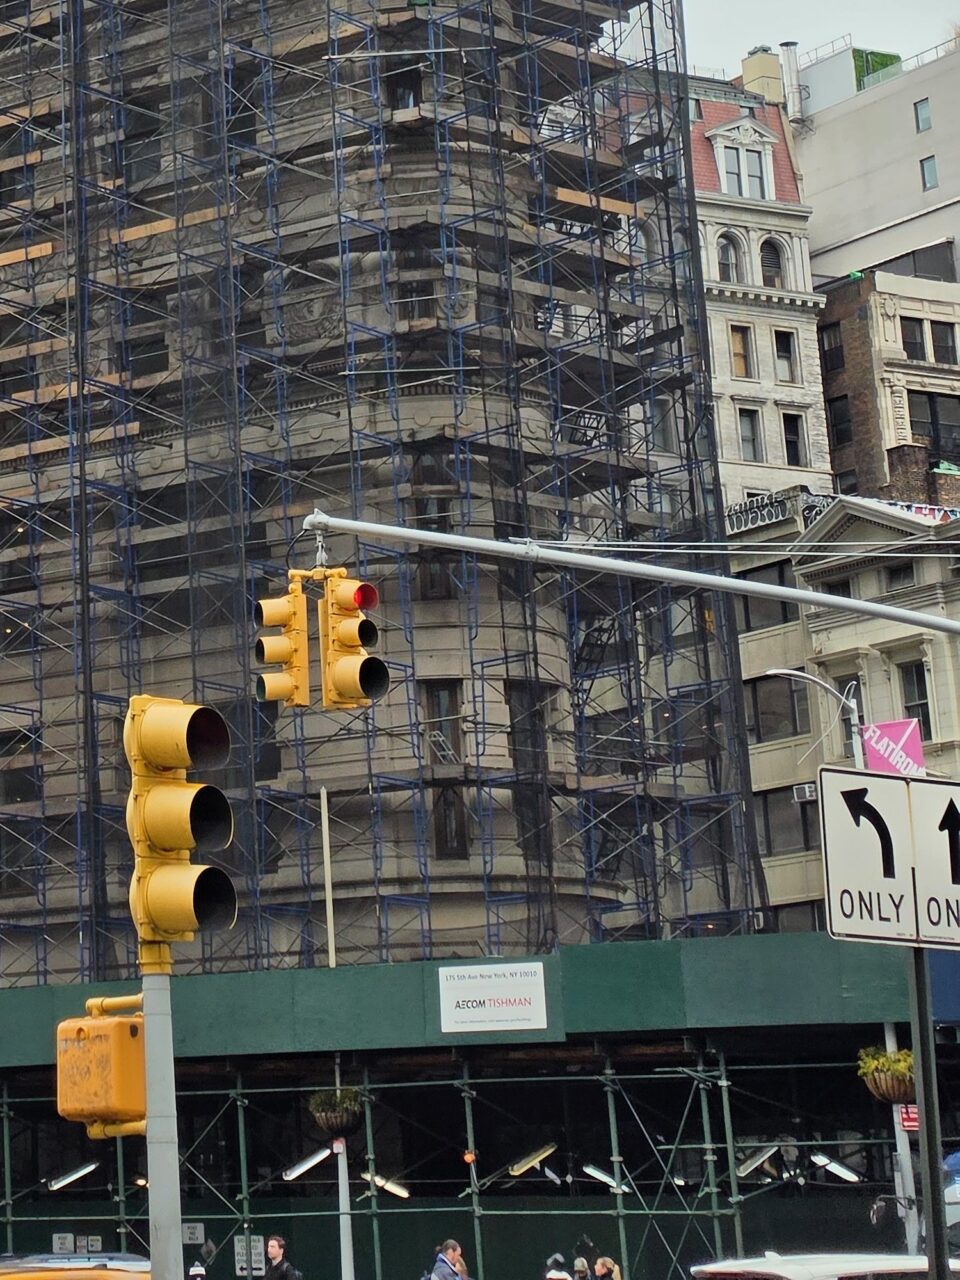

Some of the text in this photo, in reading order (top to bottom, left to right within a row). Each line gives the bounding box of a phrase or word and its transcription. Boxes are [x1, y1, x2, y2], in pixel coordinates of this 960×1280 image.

[863, 718, 927, 777] FLATIRON
[839, 888, 905, 923] ONLY
[445, 973, 456, 982] 175
[456, 973, 466, 981] 5th
[479, 972, 492, 980] New
[494, 972, 509, 980] York,
[519, 970, 537, 978] 10010
[454, 996, 532, 1010] AECOM TISHMAN
